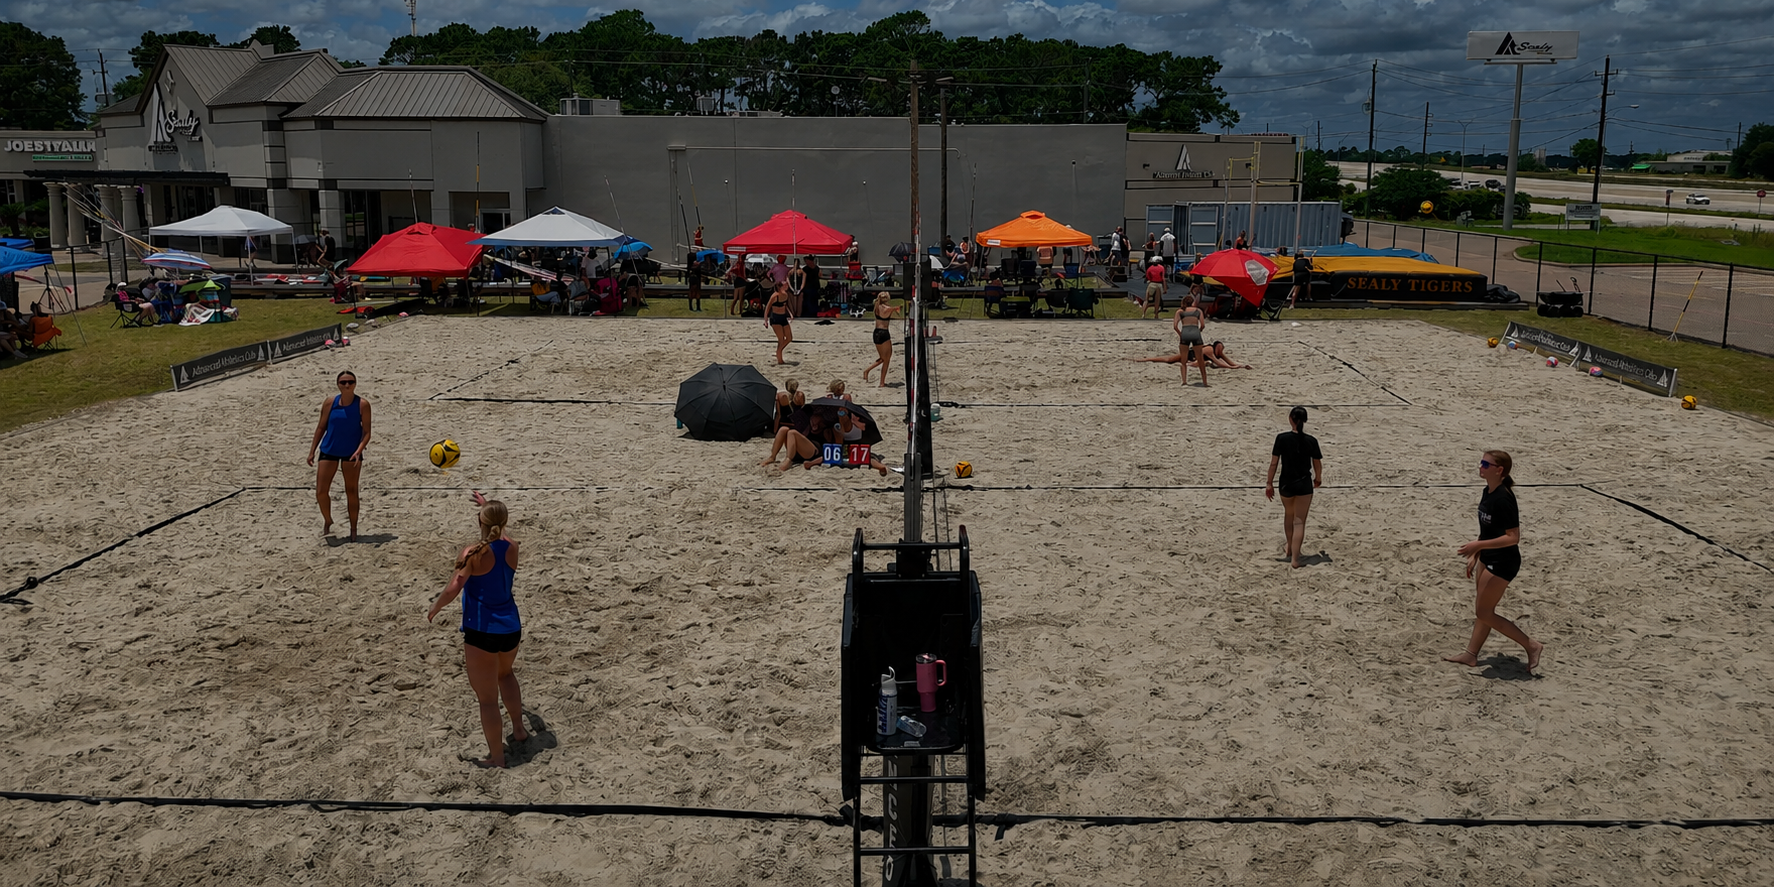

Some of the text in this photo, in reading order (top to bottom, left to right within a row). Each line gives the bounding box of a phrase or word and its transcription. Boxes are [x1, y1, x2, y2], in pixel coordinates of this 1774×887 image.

[1517, 42, 1553, 52] Sealy
[1347, 276, 1474, 293] SEALY TIGERS
[824, 446, 869, 462] 06 17
